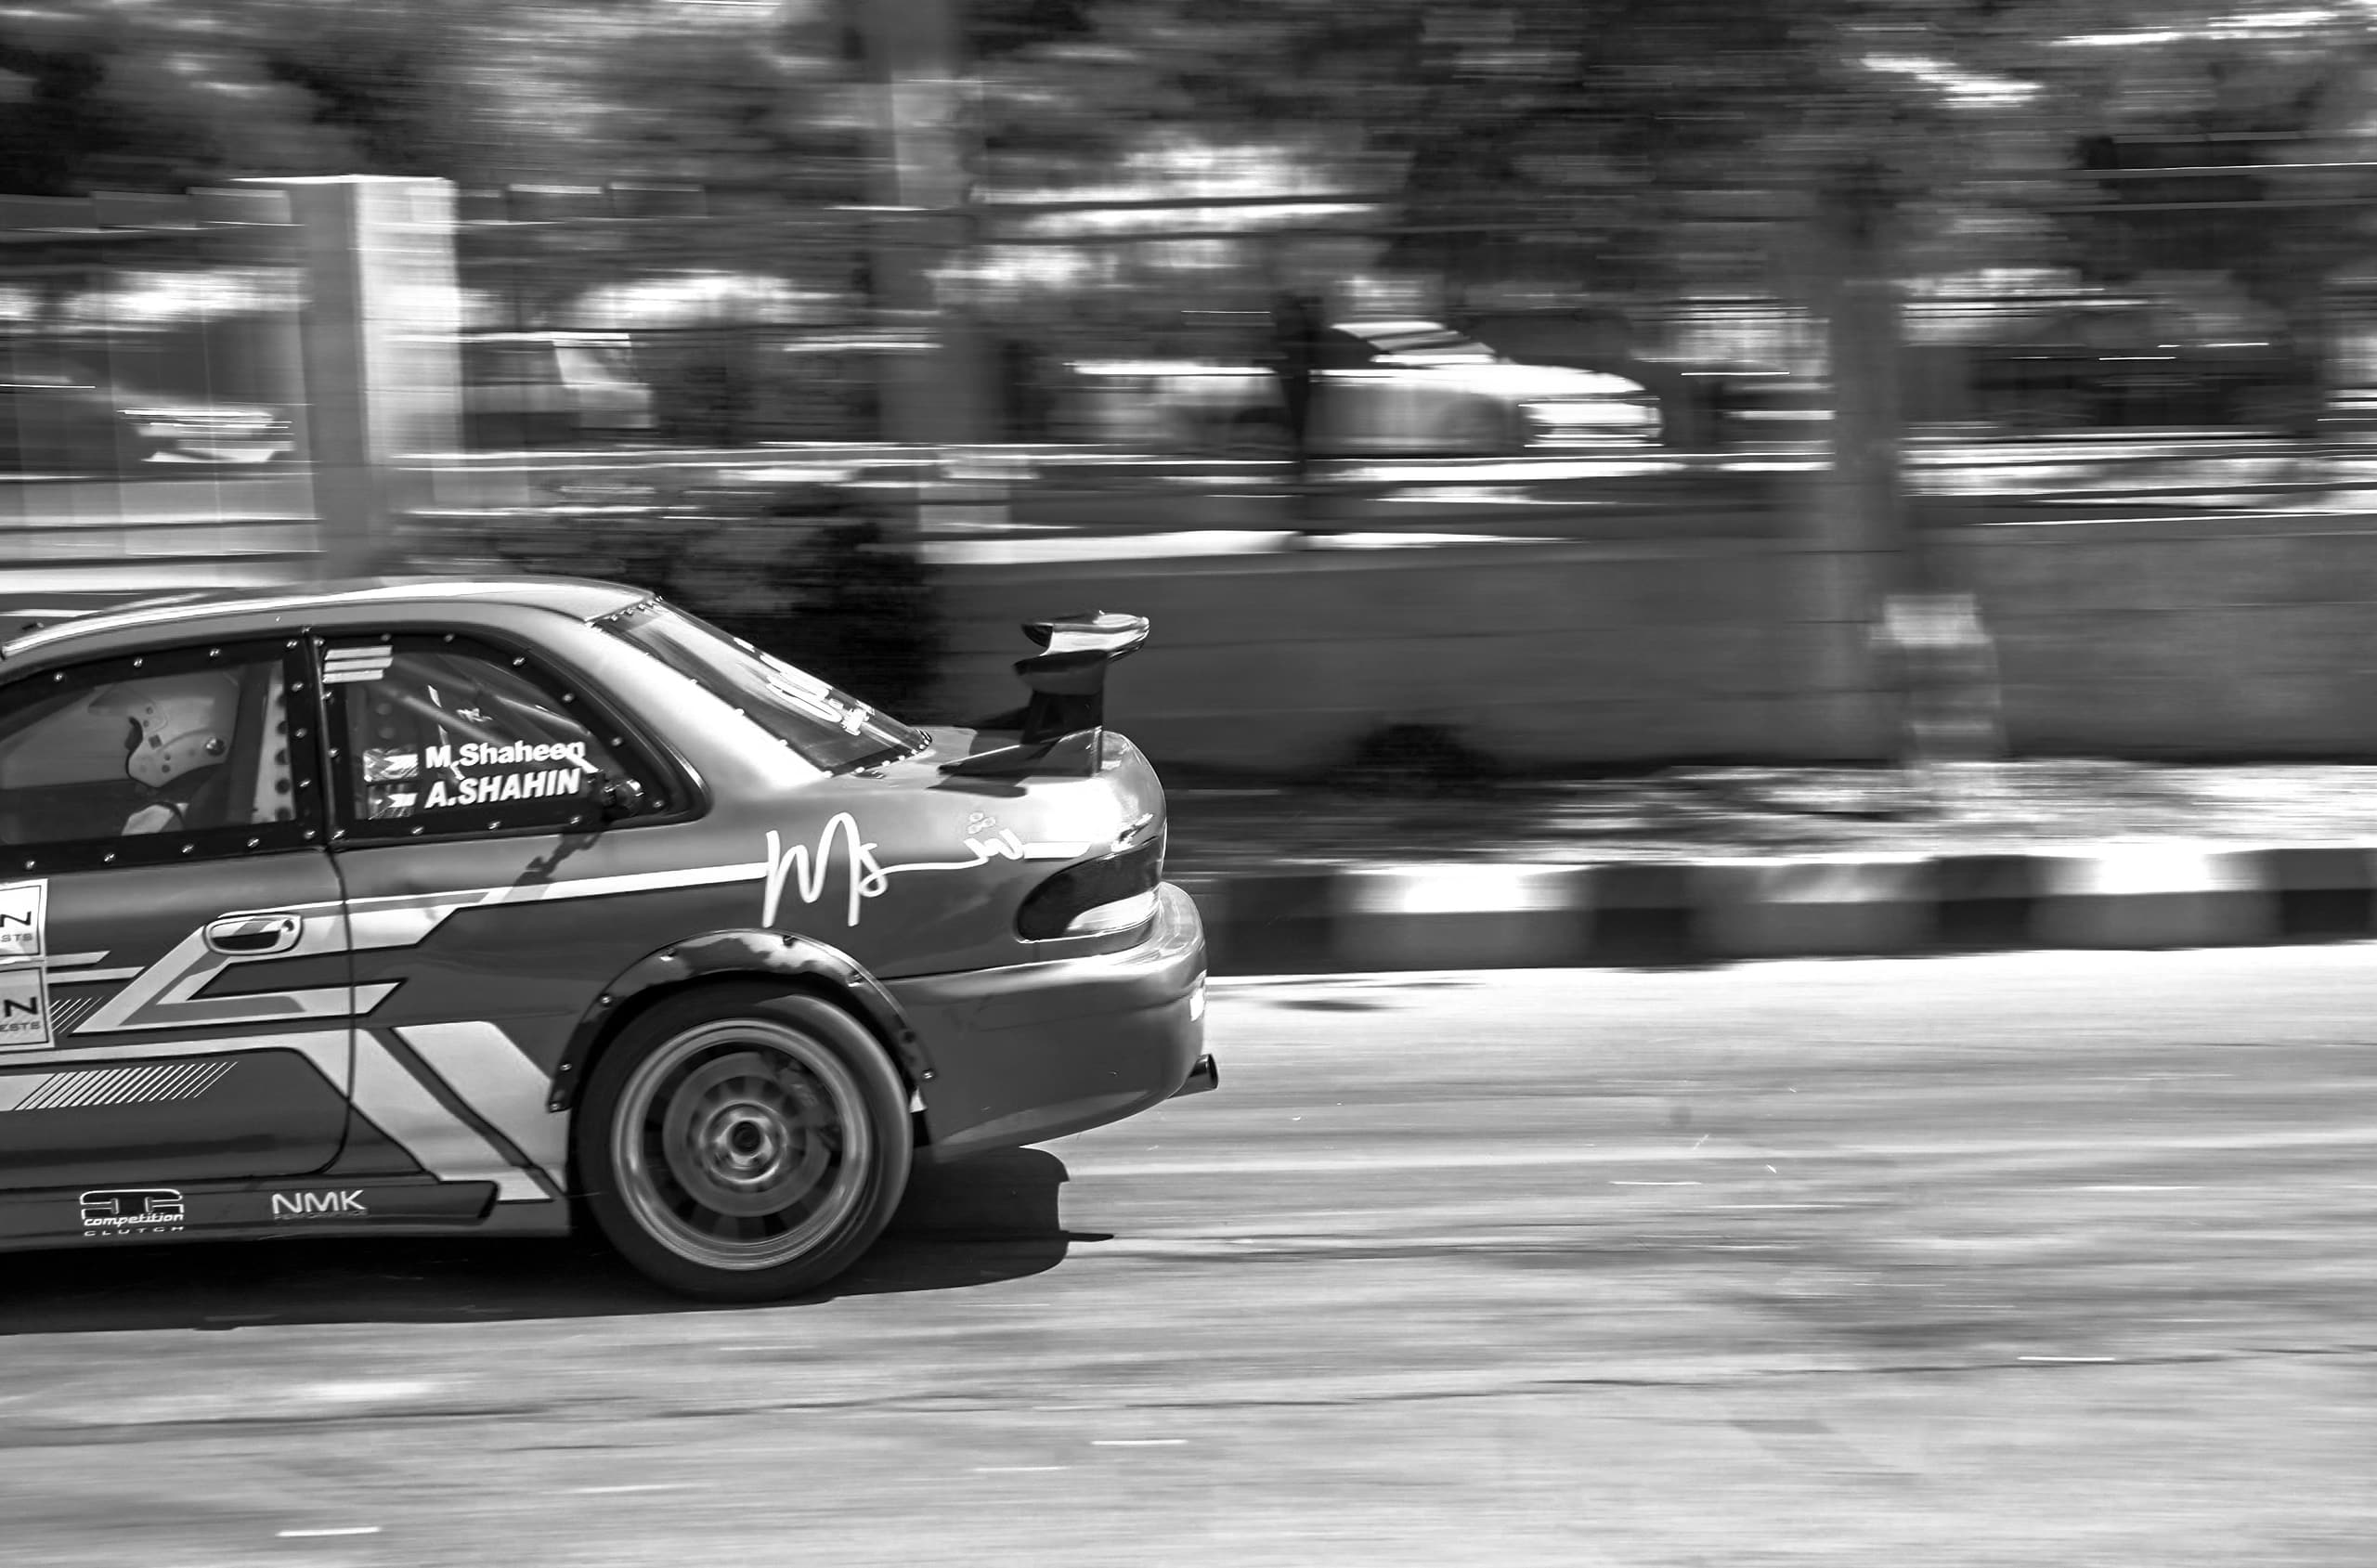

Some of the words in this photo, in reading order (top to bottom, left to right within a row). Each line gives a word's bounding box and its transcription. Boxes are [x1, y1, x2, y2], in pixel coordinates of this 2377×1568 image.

[424, 769, 581, 809] A.SHAHIN
[272, 1189, 367, 1214] NMK
[84, 1213, 184, 1227] competition
[84, 1226, 184, 1237] CLUTCH
